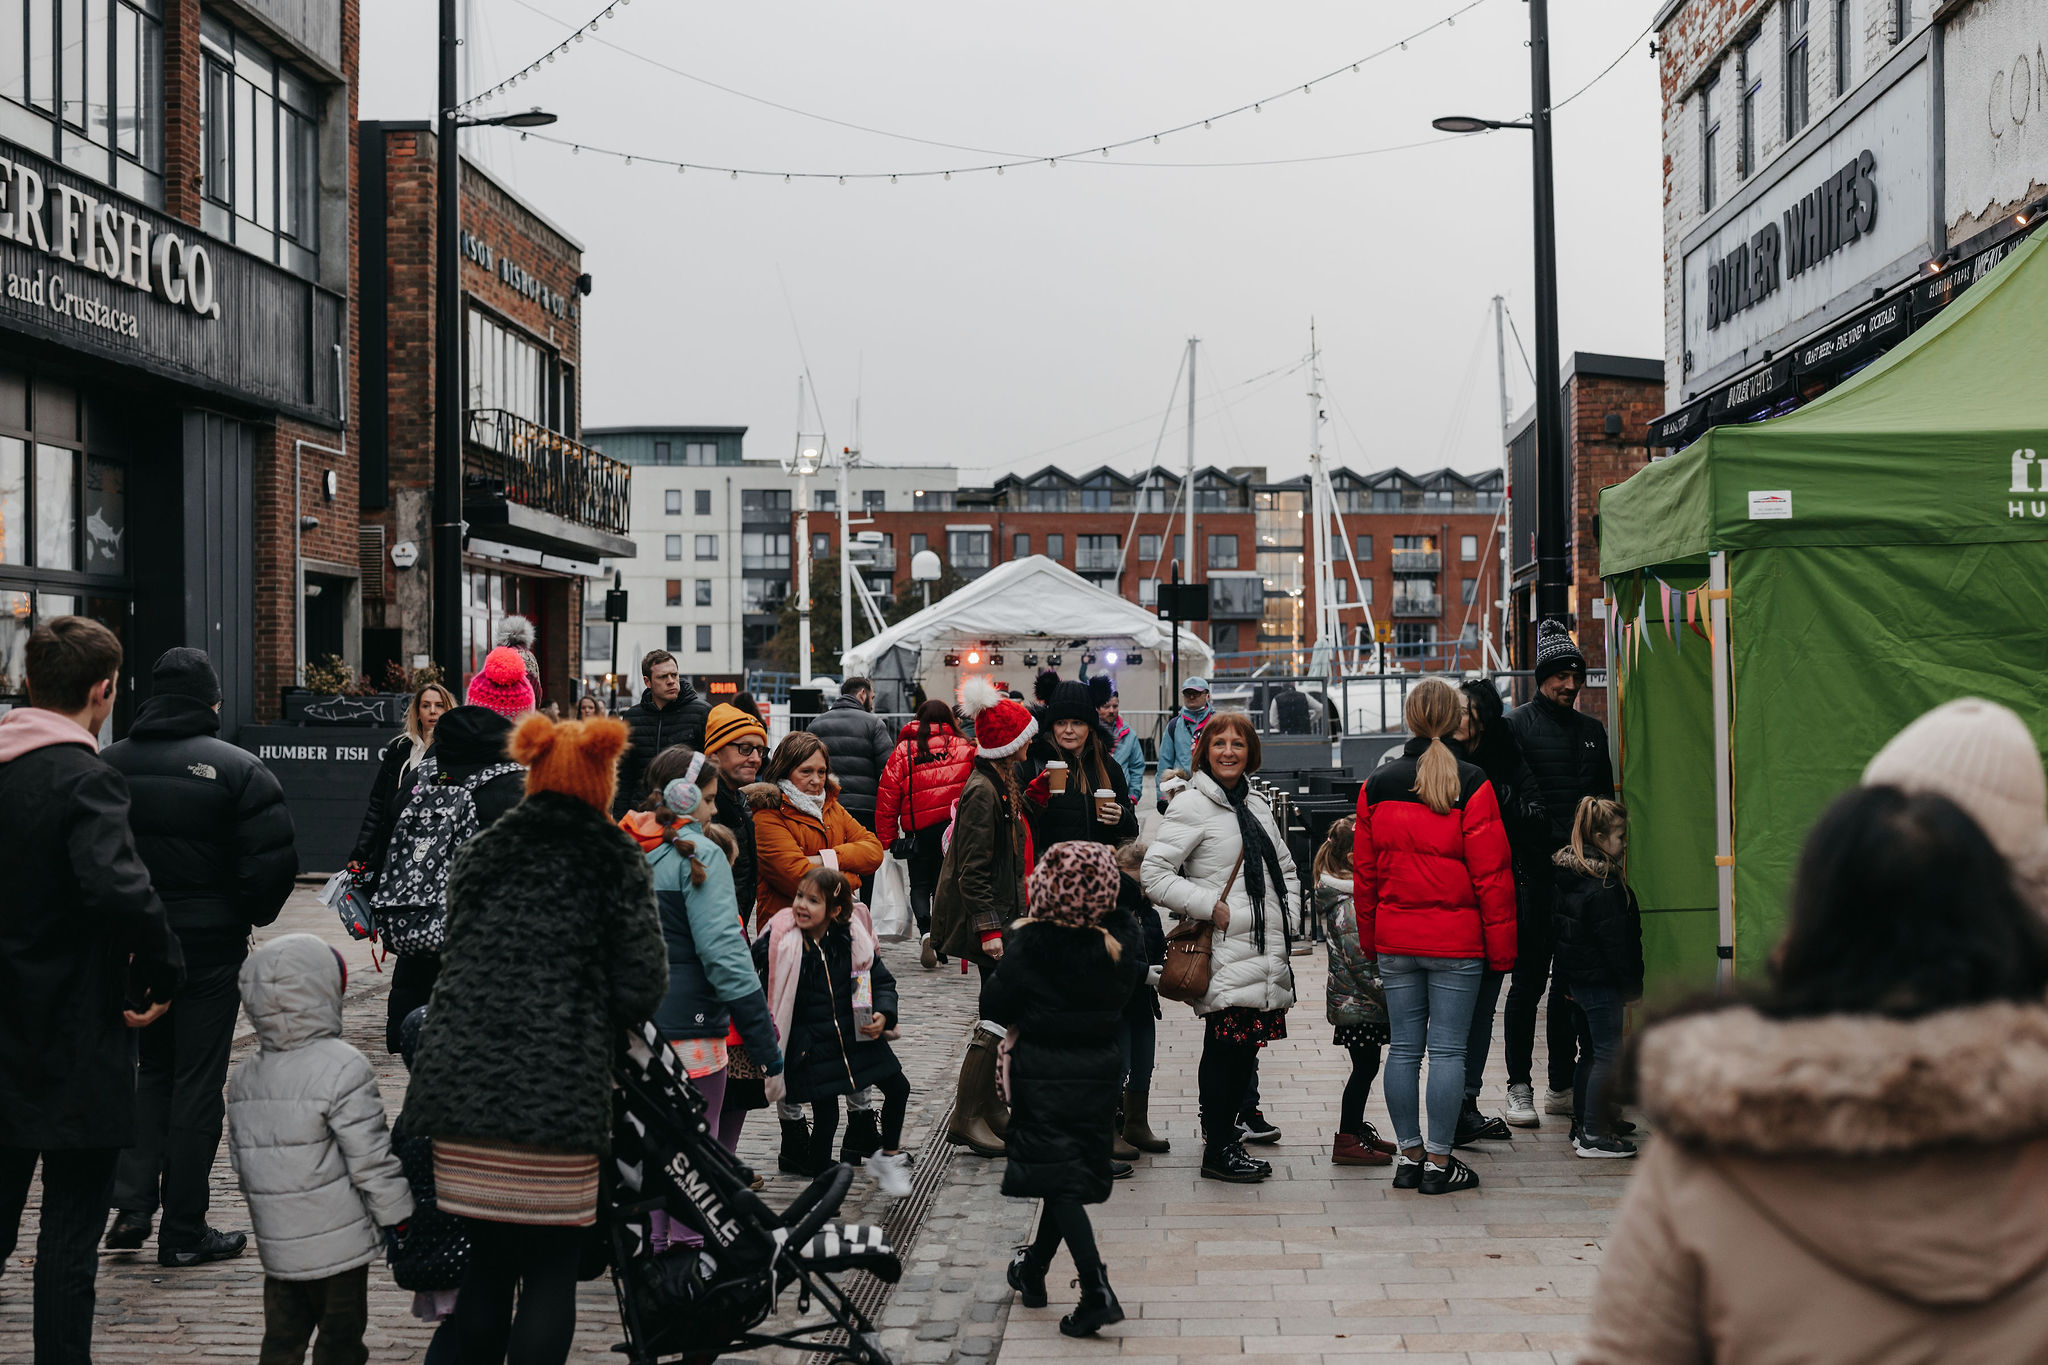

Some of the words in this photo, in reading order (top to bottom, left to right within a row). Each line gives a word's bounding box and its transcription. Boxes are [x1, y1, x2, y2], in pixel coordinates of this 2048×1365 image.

[56, 182, 153, 293] FISH
[157, 232, 221, 321] CO.
[1707, 222, 1780, 331] BUTLER
[1783, 149, 1876, 280] WHITES
[8, 269, 45, 306] and
[50, 275, 139, 338] Crustacea
[1928, 275, 1953, 299] GLORIOUS
[1953, 265, 1970, 287] TAPAS
[1868, 305, 1897, 333] COCKTAILS
[1749, 366, 1773, 398] WHITES
[259, 745, 328, 760] HUMBER
[336, 747, 369, 761] FISH
[672, 1152, 740, 1242] SMILE
